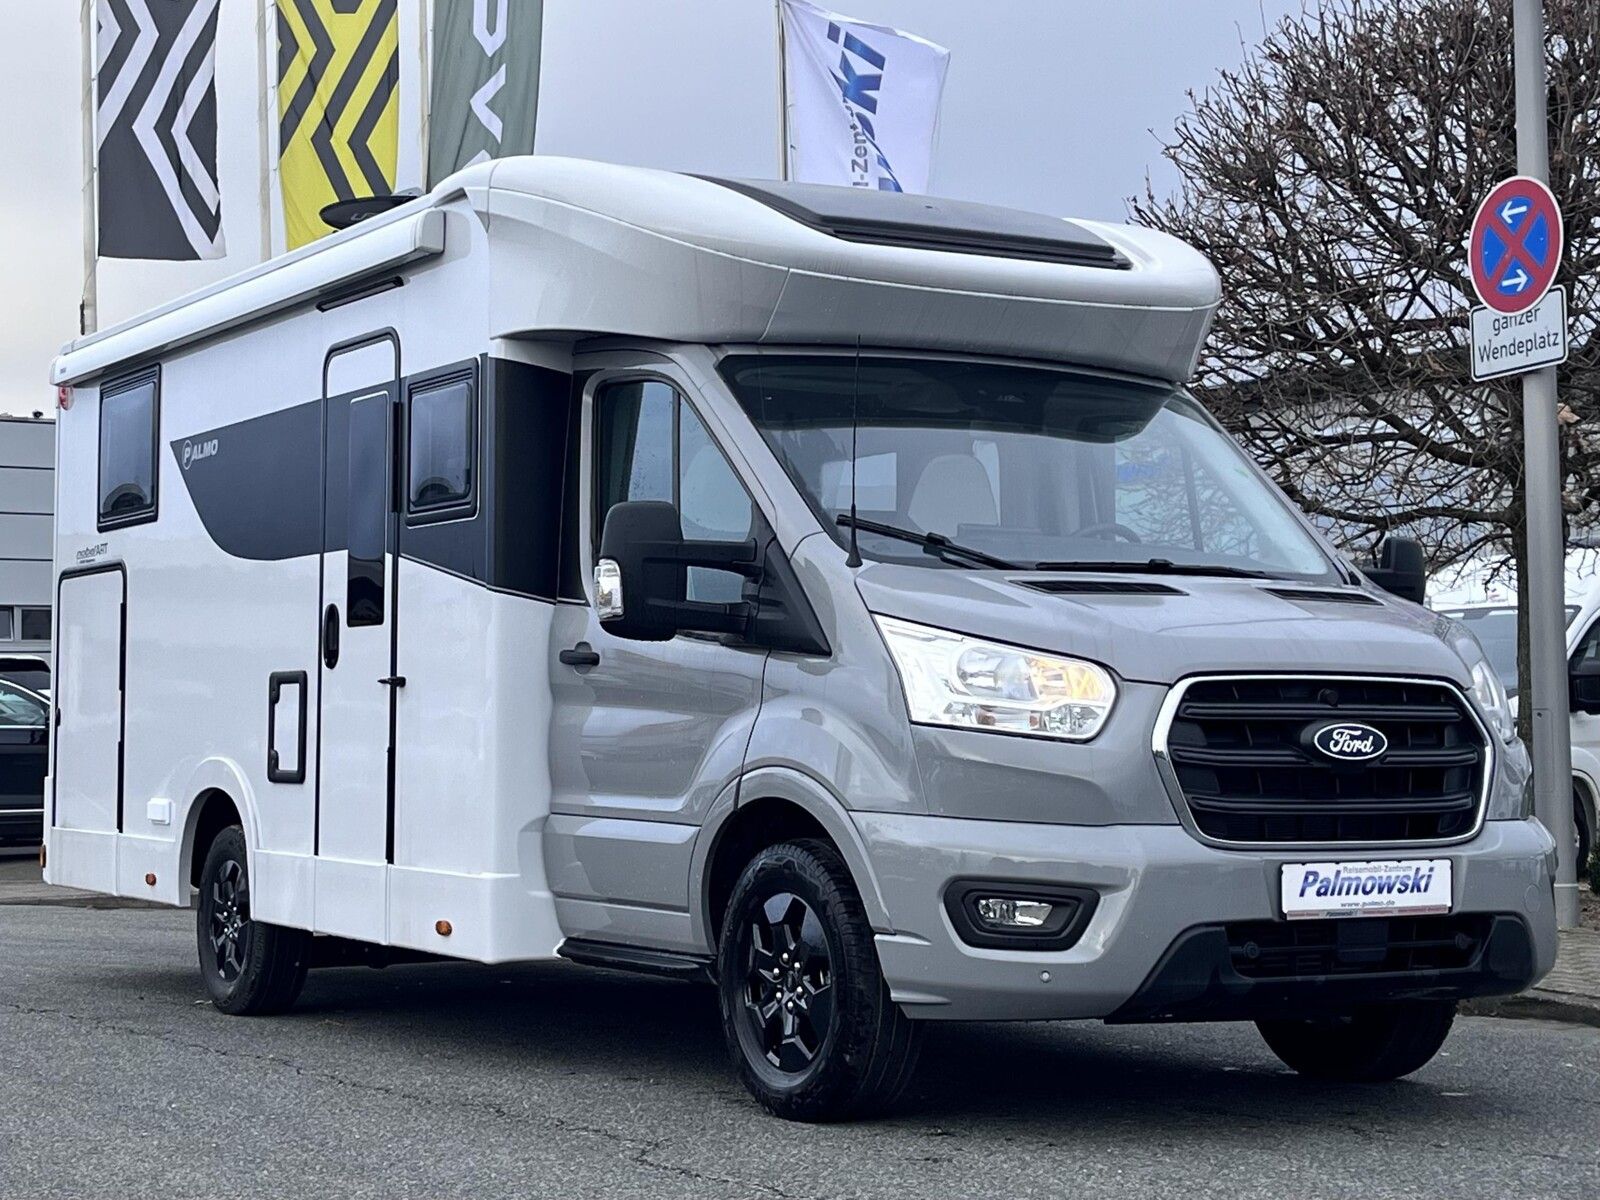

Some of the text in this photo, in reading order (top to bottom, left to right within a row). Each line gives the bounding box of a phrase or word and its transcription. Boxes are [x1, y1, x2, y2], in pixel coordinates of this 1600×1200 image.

[1492, 307, 1541, 337] ganzer
[1478, 331, 1560, 363] Wendeplatz
[182, 439, 219, 470] PALMO
[1329, 728, 1374, 753] Ford
[1299, 866, 1435, 898] Palmowski
[1342, 864, 1413, 874] Reisemobil-Zentrum
[1340, 899, 1396, 908] www.palmo.de
